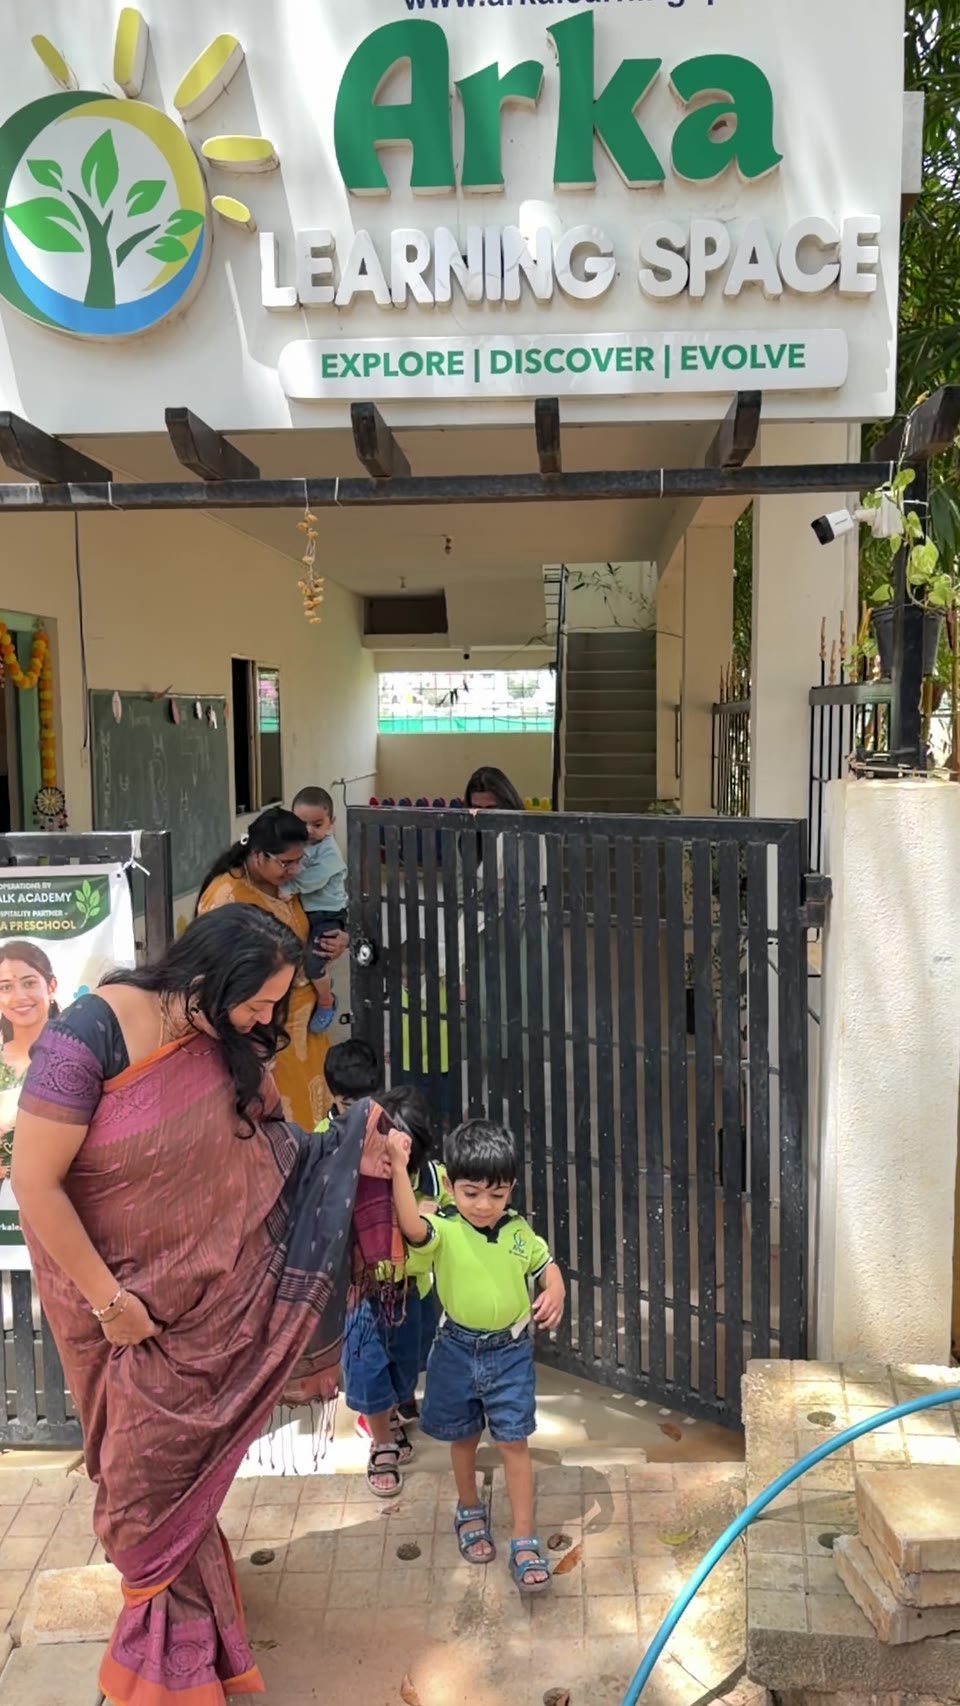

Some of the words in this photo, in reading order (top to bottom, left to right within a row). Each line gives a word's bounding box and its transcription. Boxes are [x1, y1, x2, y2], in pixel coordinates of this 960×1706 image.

[334, 10, 784, 194] Arka
[259, 223, 617, 308] LEARNING
[638, 213, 881, 298] SPACE
[321, 349, 464, 379] EXPLORE
[490, 345, 655, 376] DISCOVER
[681, 342, 807, 372] EVOLVE
[0, 893, 16, 904] LK
[17, 891, 73, 904] ACADEMY
[9, 919, 77, 931] PRESCHOOL
